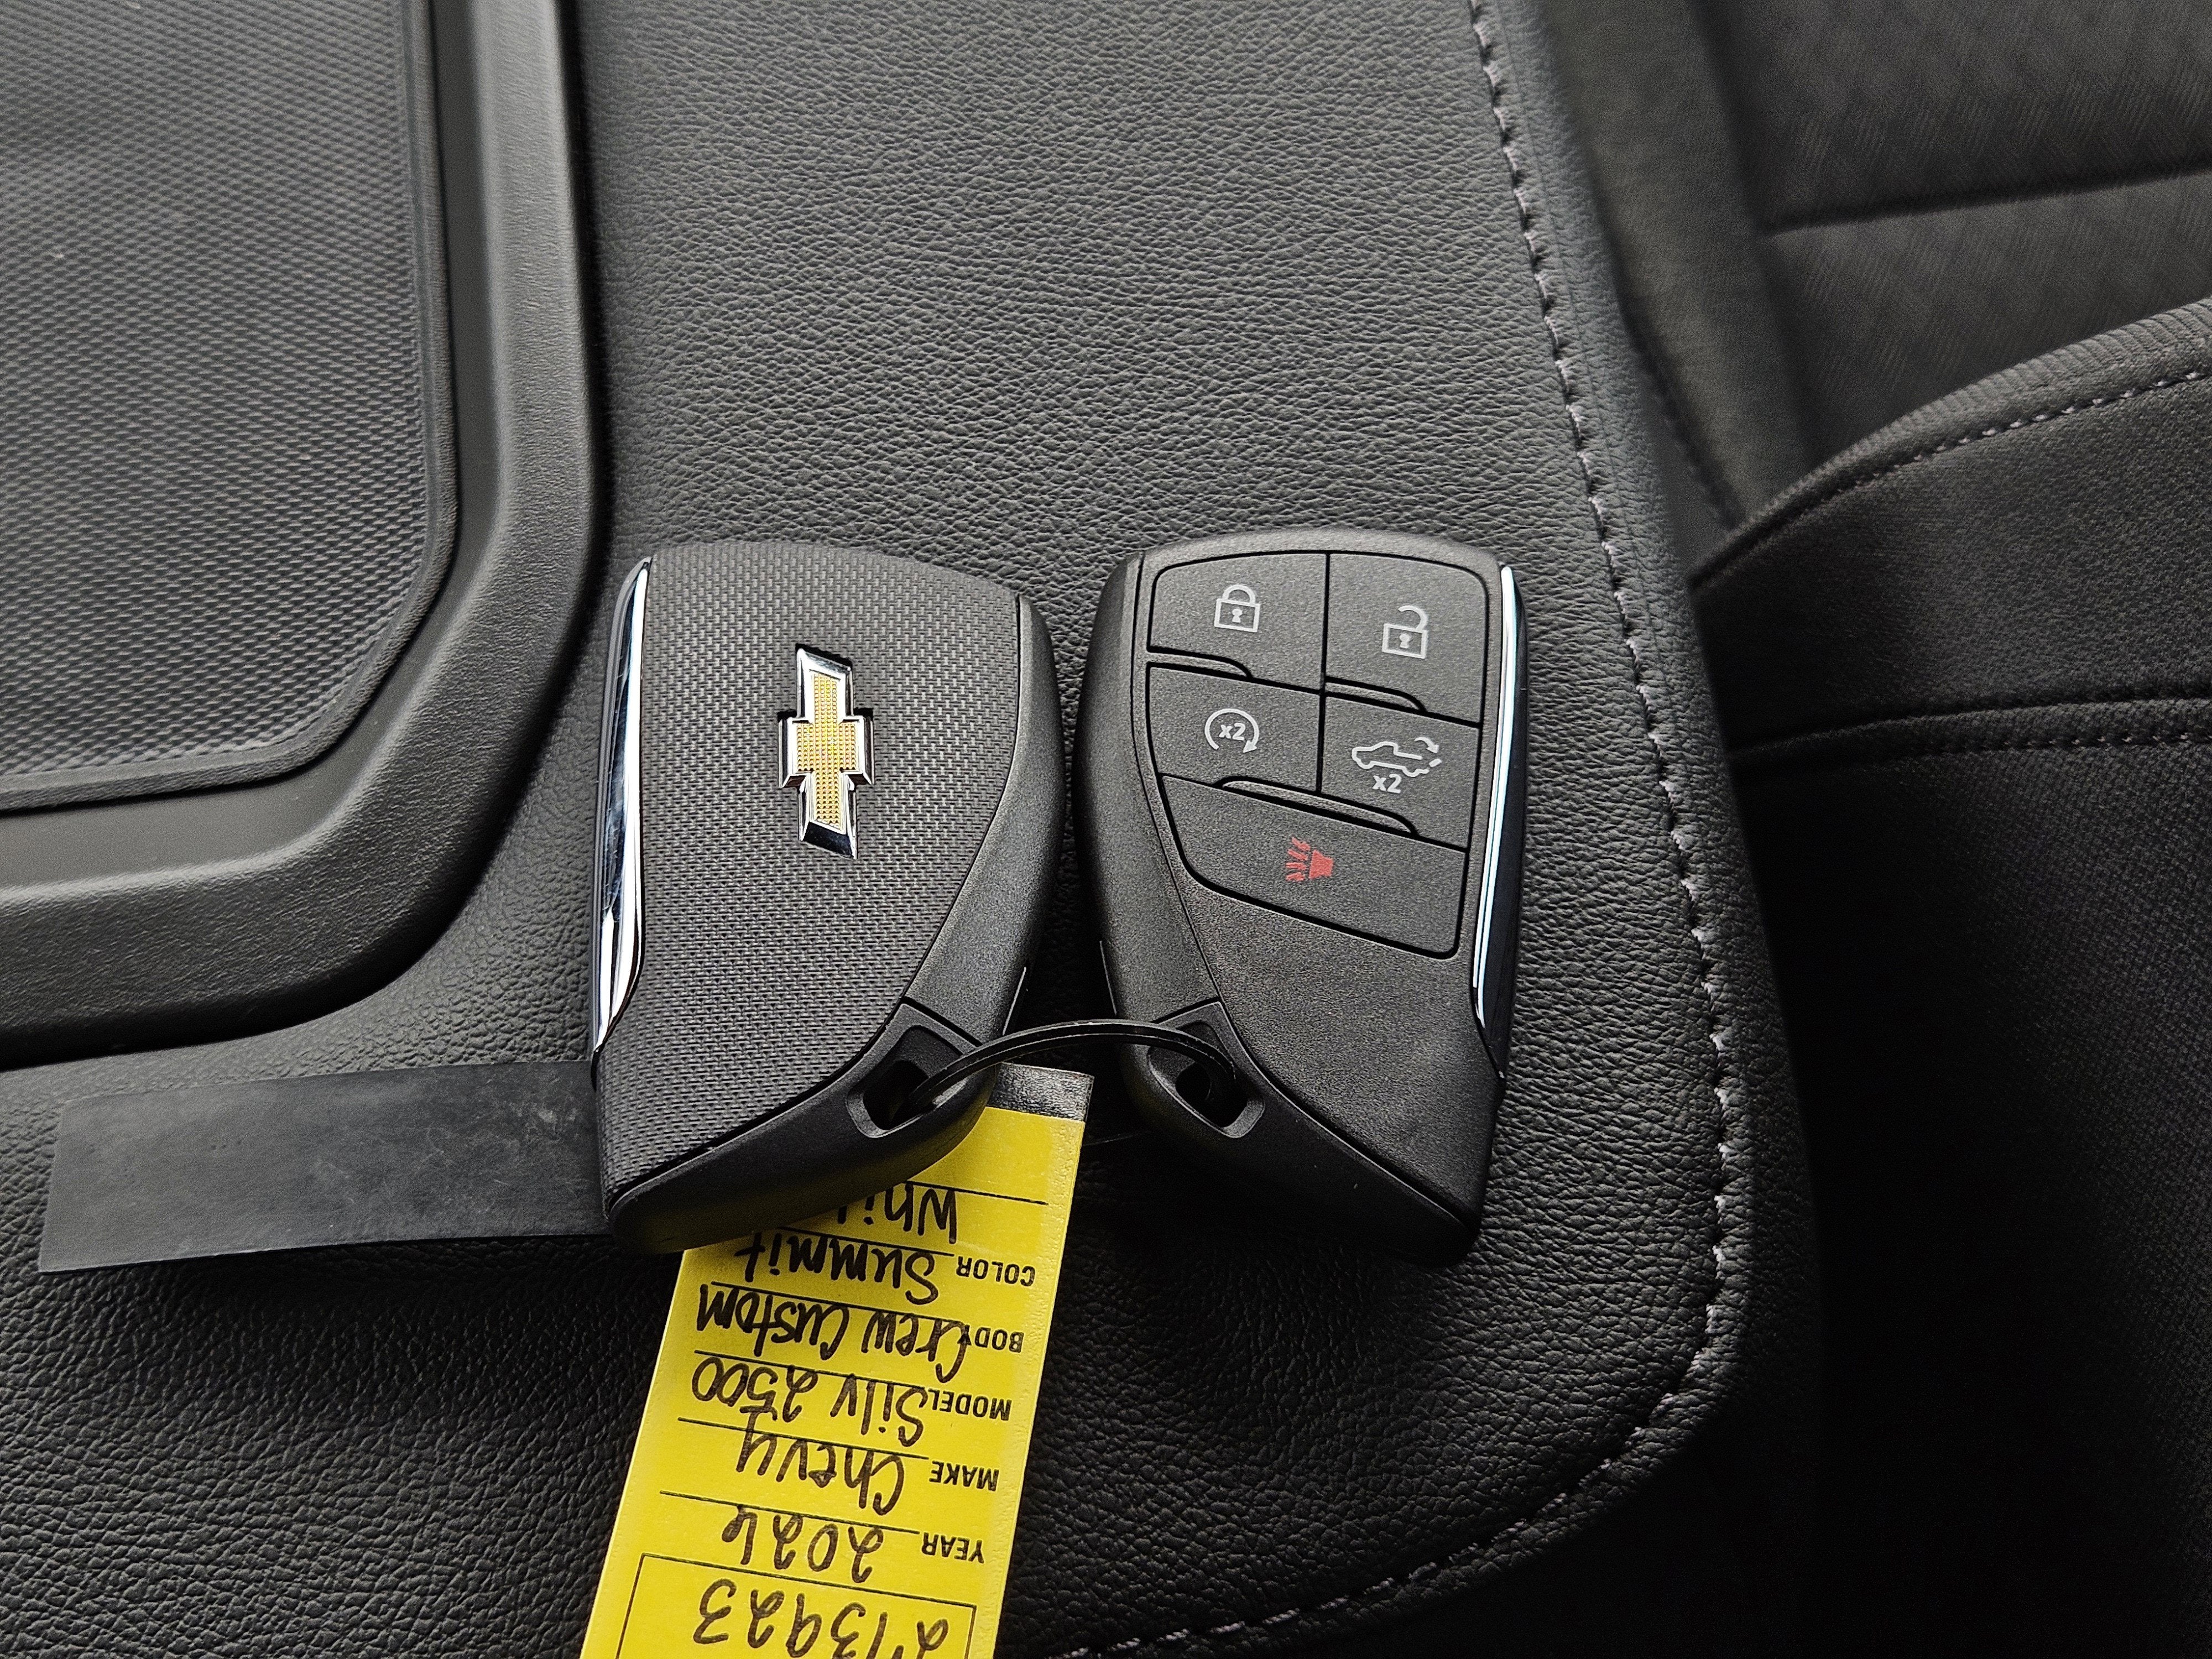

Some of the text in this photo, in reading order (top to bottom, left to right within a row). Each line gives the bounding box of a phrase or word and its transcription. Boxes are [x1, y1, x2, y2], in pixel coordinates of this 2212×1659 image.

[1218, 723, 1246, 742] x2
[1372, 774, 1401, 794] x2
[735, 1230, 939, 1306] Summit
[954, 1255, 1036, 1287] COLOR
[696, 1284, 968, 1383] Crew Custom
[961, 1324, 1024, 1353] BODY
[692, 1355, 927, 1447] Silv 2500
[929, 1387, 1011, 1421] MODEL
[735, 1406, 905, 1514] Chevy
[929, 1461, 999, 1491] MAKE
[721, 1504, 884, 1583] 2026
[922, 1531, 985, 1563] YEAR
